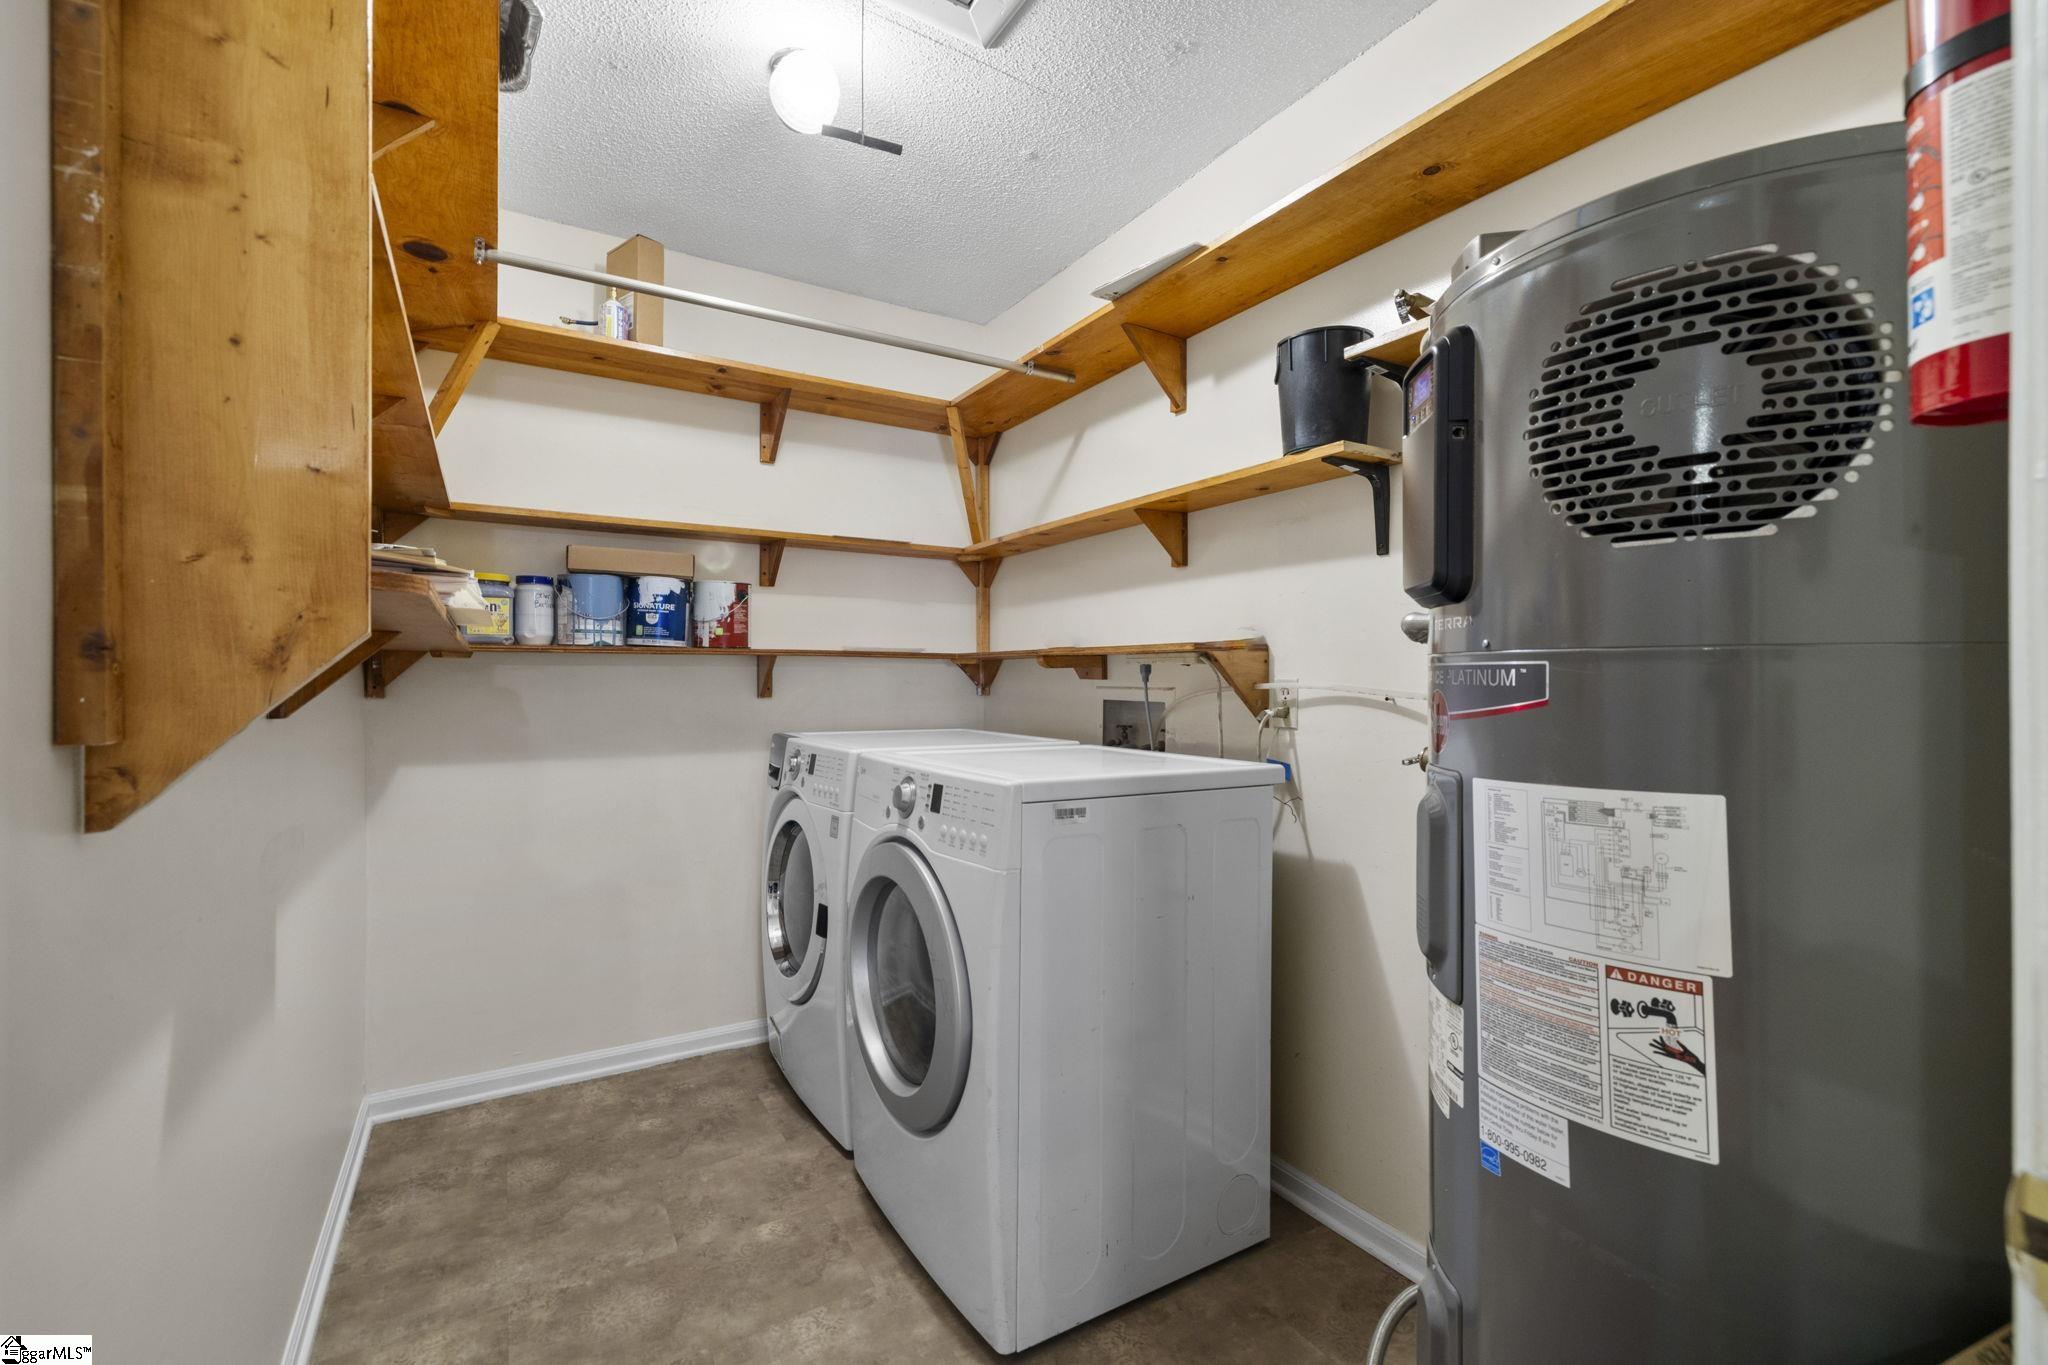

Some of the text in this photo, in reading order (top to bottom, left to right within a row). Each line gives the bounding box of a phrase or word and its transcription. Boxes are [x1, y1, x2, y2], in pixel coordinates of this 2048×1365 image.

[1568, 956, 1598, 969] CAUTION
[1627, 971, 1697, 993] DANGER
[1661, 1028, 1680, 1037] HOT
[1481, 1125, 1548, 1171] 1-800-995-0982
